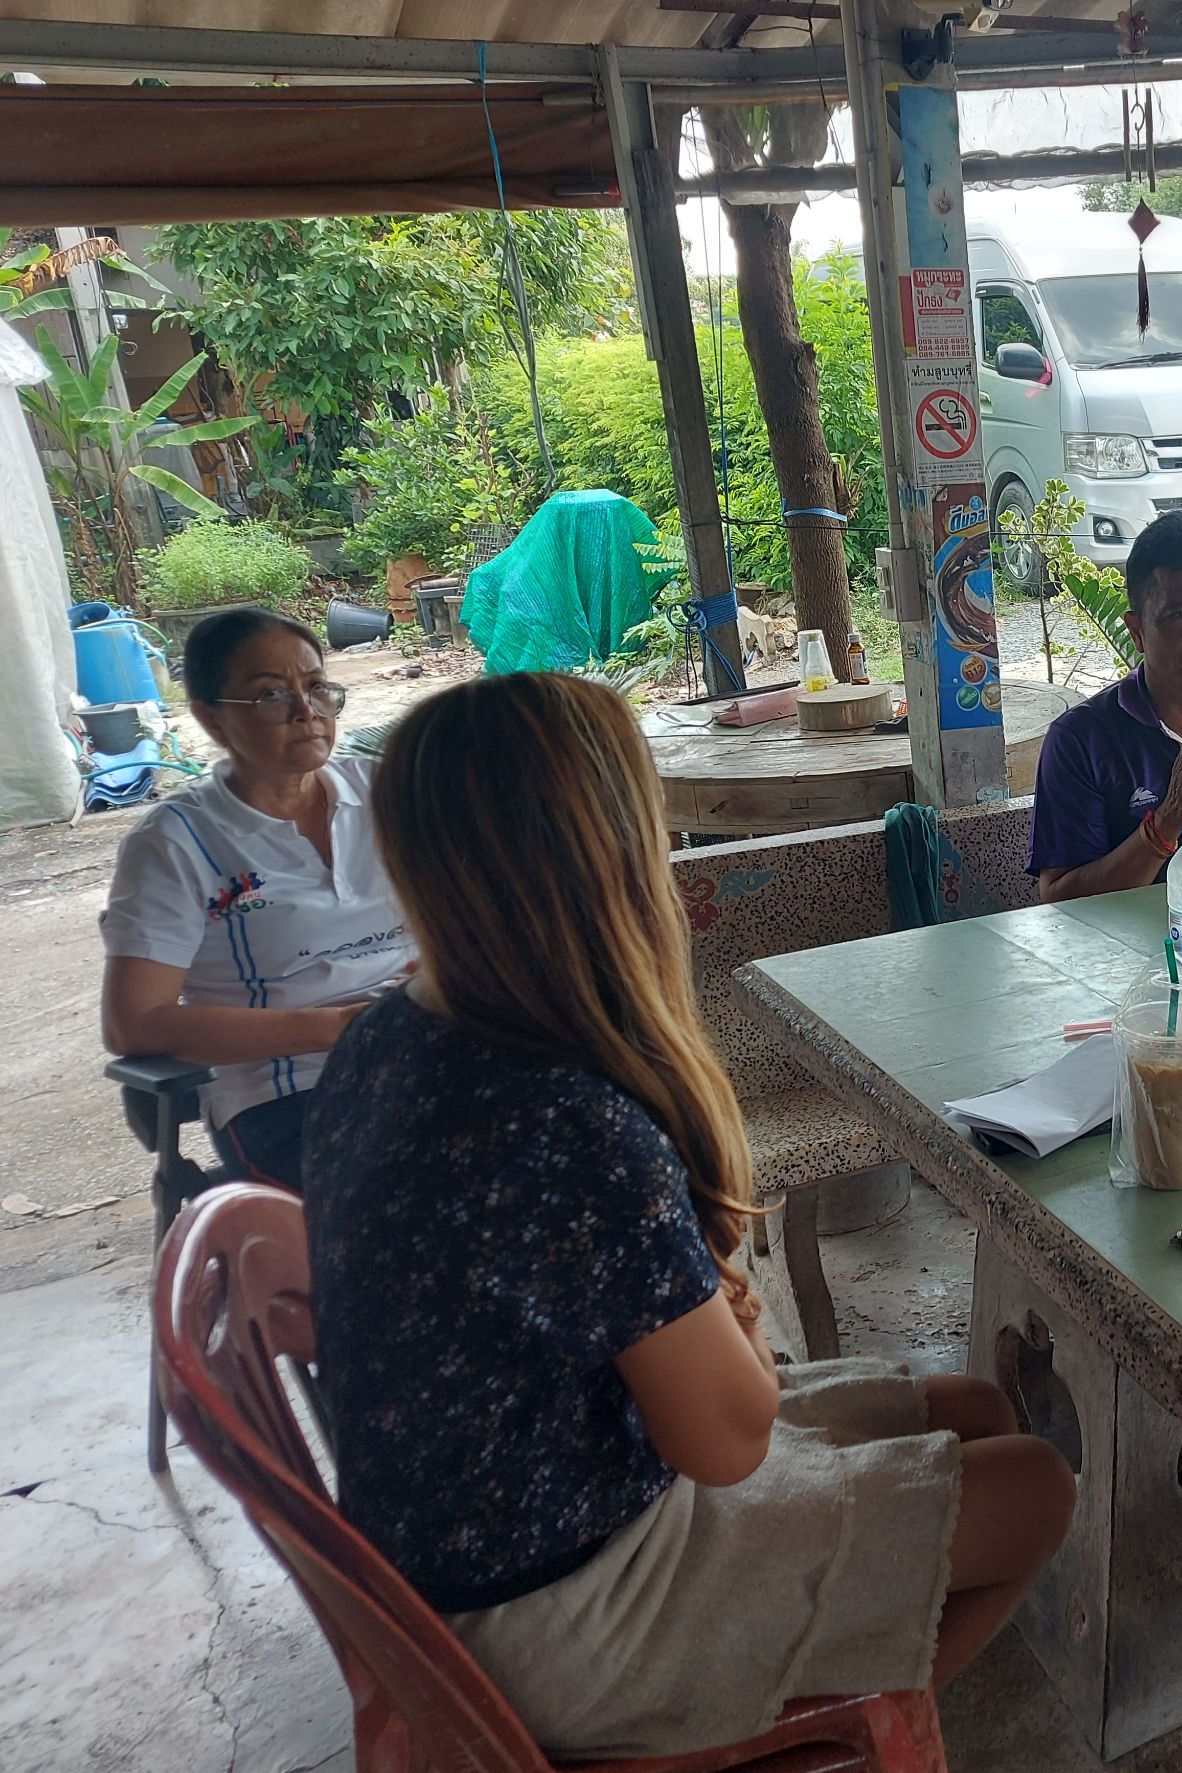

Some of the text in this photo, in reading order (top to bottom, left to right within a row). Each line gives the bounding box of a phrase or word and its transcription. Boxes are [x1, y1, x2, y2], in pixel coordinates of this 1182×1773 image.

[916, 271, 961, 287] หมูกระทะ
[912, 361, 972, 380] ห้ามสูบบุหรี่
[950, 505, 988, 532] ดีมอล
